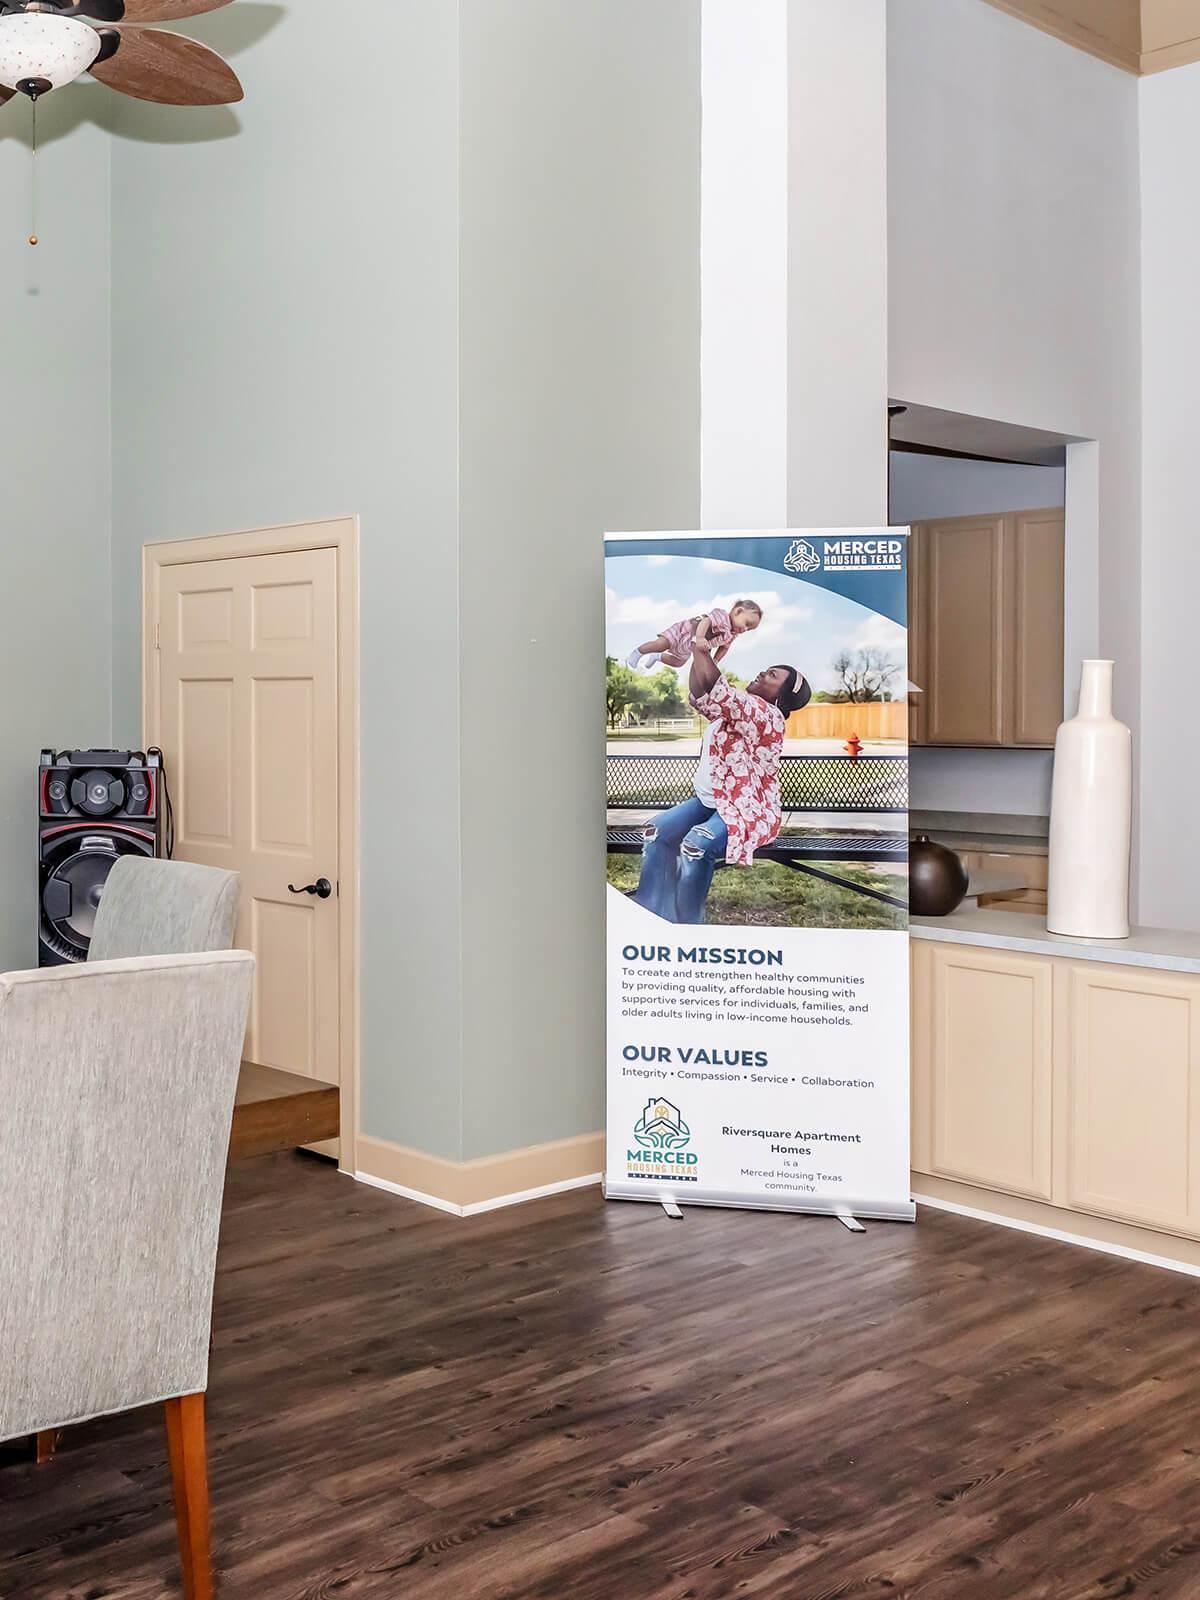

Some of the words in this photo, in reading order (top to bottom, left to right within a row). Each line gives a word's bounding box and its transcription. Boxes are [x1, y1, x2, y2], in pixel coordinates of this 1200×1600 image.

[824, 540, 902, 555] MERCED
[824, 555, 867, 565] HOUSING
[870, 554, 901, 565] TEXAS
[622, 945, 671, 962] OUR
[677, 946, 783, 966] MISSION
[622, 967, 635, 976] To
[637, 968, 670, 978] create
[673, 969, 692, 978] and
[695, 970, 752, 981] strengthen
[755, 972, 794, 983] healthy
[797, 975, 865, 985] communities
[622, 981, 634, 990] by
[637, 982, 686, 993] providing
[688, 983, 726, 994] quality,
[729, 984, 785, 996] affordable
[787, 986, 829, 998] housing
[832, 988, 856, 998] with
[622, 994, 677, 1005] supportive
[680, 996, 720, 1006] services
[723, 997, 738, 1007] for
[741, 999, 799, 1011] individuals,
[802, 1001, 846, 1012] families,
[848, 1003, 869, 1013] and
[622, 1008, 648, 1017] older
[650, 1009, 682, 1018] adults
[685, 1010, 712, 1021] living
[715, 1011, 724, 1020] in
[727, 1012, 788, 1023] low-income
[790, 1014, 853, 1026] households.
[622, 1045, 672, 1063] OUR
[677, 1047, 768, 1067] VALUES
[622, 1067, 667, 1079] Integrity
[677, 1070, 741, 1081] Compassion
[750, 1073, 789, 1084] Service
[801, 1076, 875, 1089] Collaboration
[722, 1126, 792, 1139] Riversquare
[794, 1130, 862, 1143] Apartment
[627, 1149, 698, 1165] MERCED
[770, 1144, 812, 1155] Homes
[627, 1162, 667, 1173] HOUSING
[671, 1165, 698, 1175] TEXAS
[783, 1158, 791, 1167] is
[792, 1160, 799, 1168] a
[740, 1168, 774, 1178] Merced
[776, 1170, 814, 1181] Housing
[816, 1172, 843, 1182] Texas
[764, 1181, 818, 1193] community.
